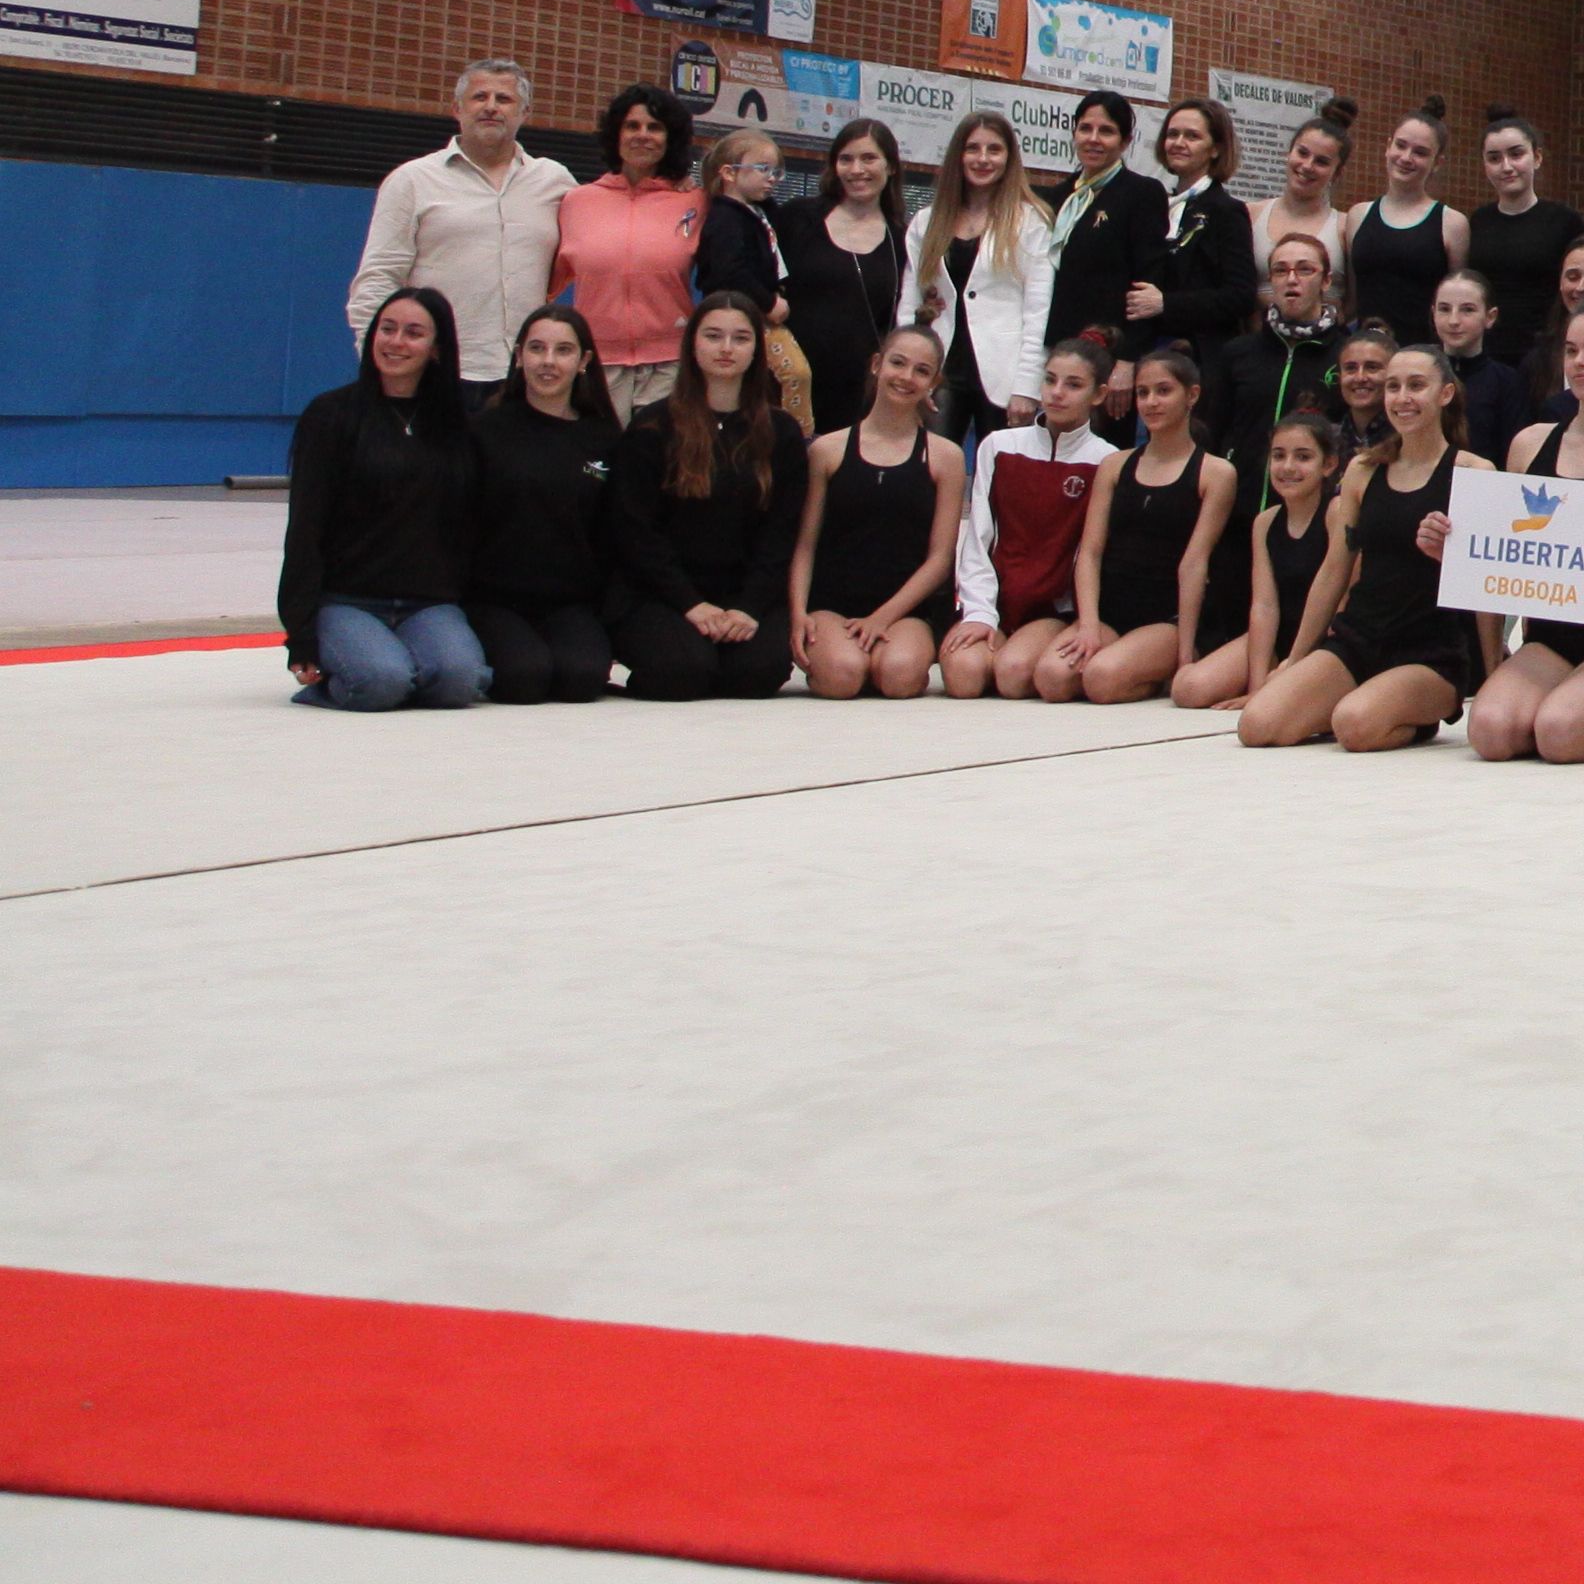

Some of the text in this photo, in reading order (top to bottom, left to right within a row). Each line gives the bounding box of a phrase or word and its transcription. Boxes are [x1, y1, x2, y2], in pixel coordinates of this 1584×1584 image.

[1271, 88, 1282, 104] DE
[1284, 90, 1314, 109] VALORS
[1484, 574, 1579, 607] СВОБОДА
